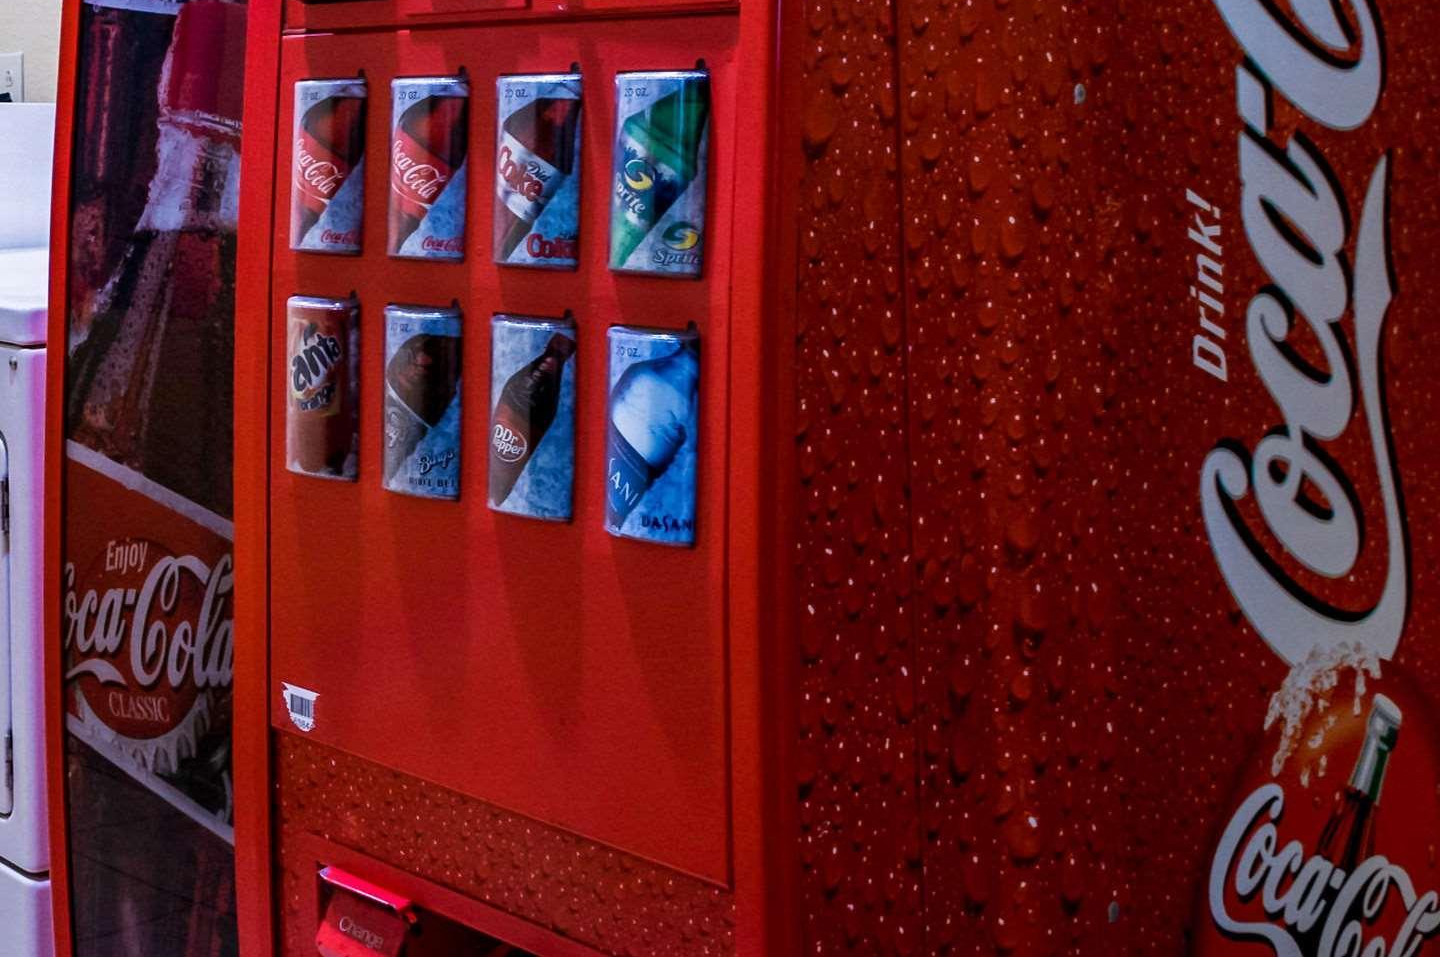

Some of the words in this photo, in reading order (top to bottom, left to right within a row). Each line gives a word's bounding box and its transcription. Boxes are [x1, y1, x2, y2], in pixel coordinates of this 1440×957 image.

[615, 177, 646, 213] prite
[1185, 188, 1228, 382] Drink!
[292, 334, 341, 392] anta
[640, 515, 692, 532] DASAN
[105, 539, 148, 574] Enjoy
[66, 554, 233, 687] oca-Cola
[110, 691, 170, 722] CLASSIC
[339, 916, 384, 949] Change
